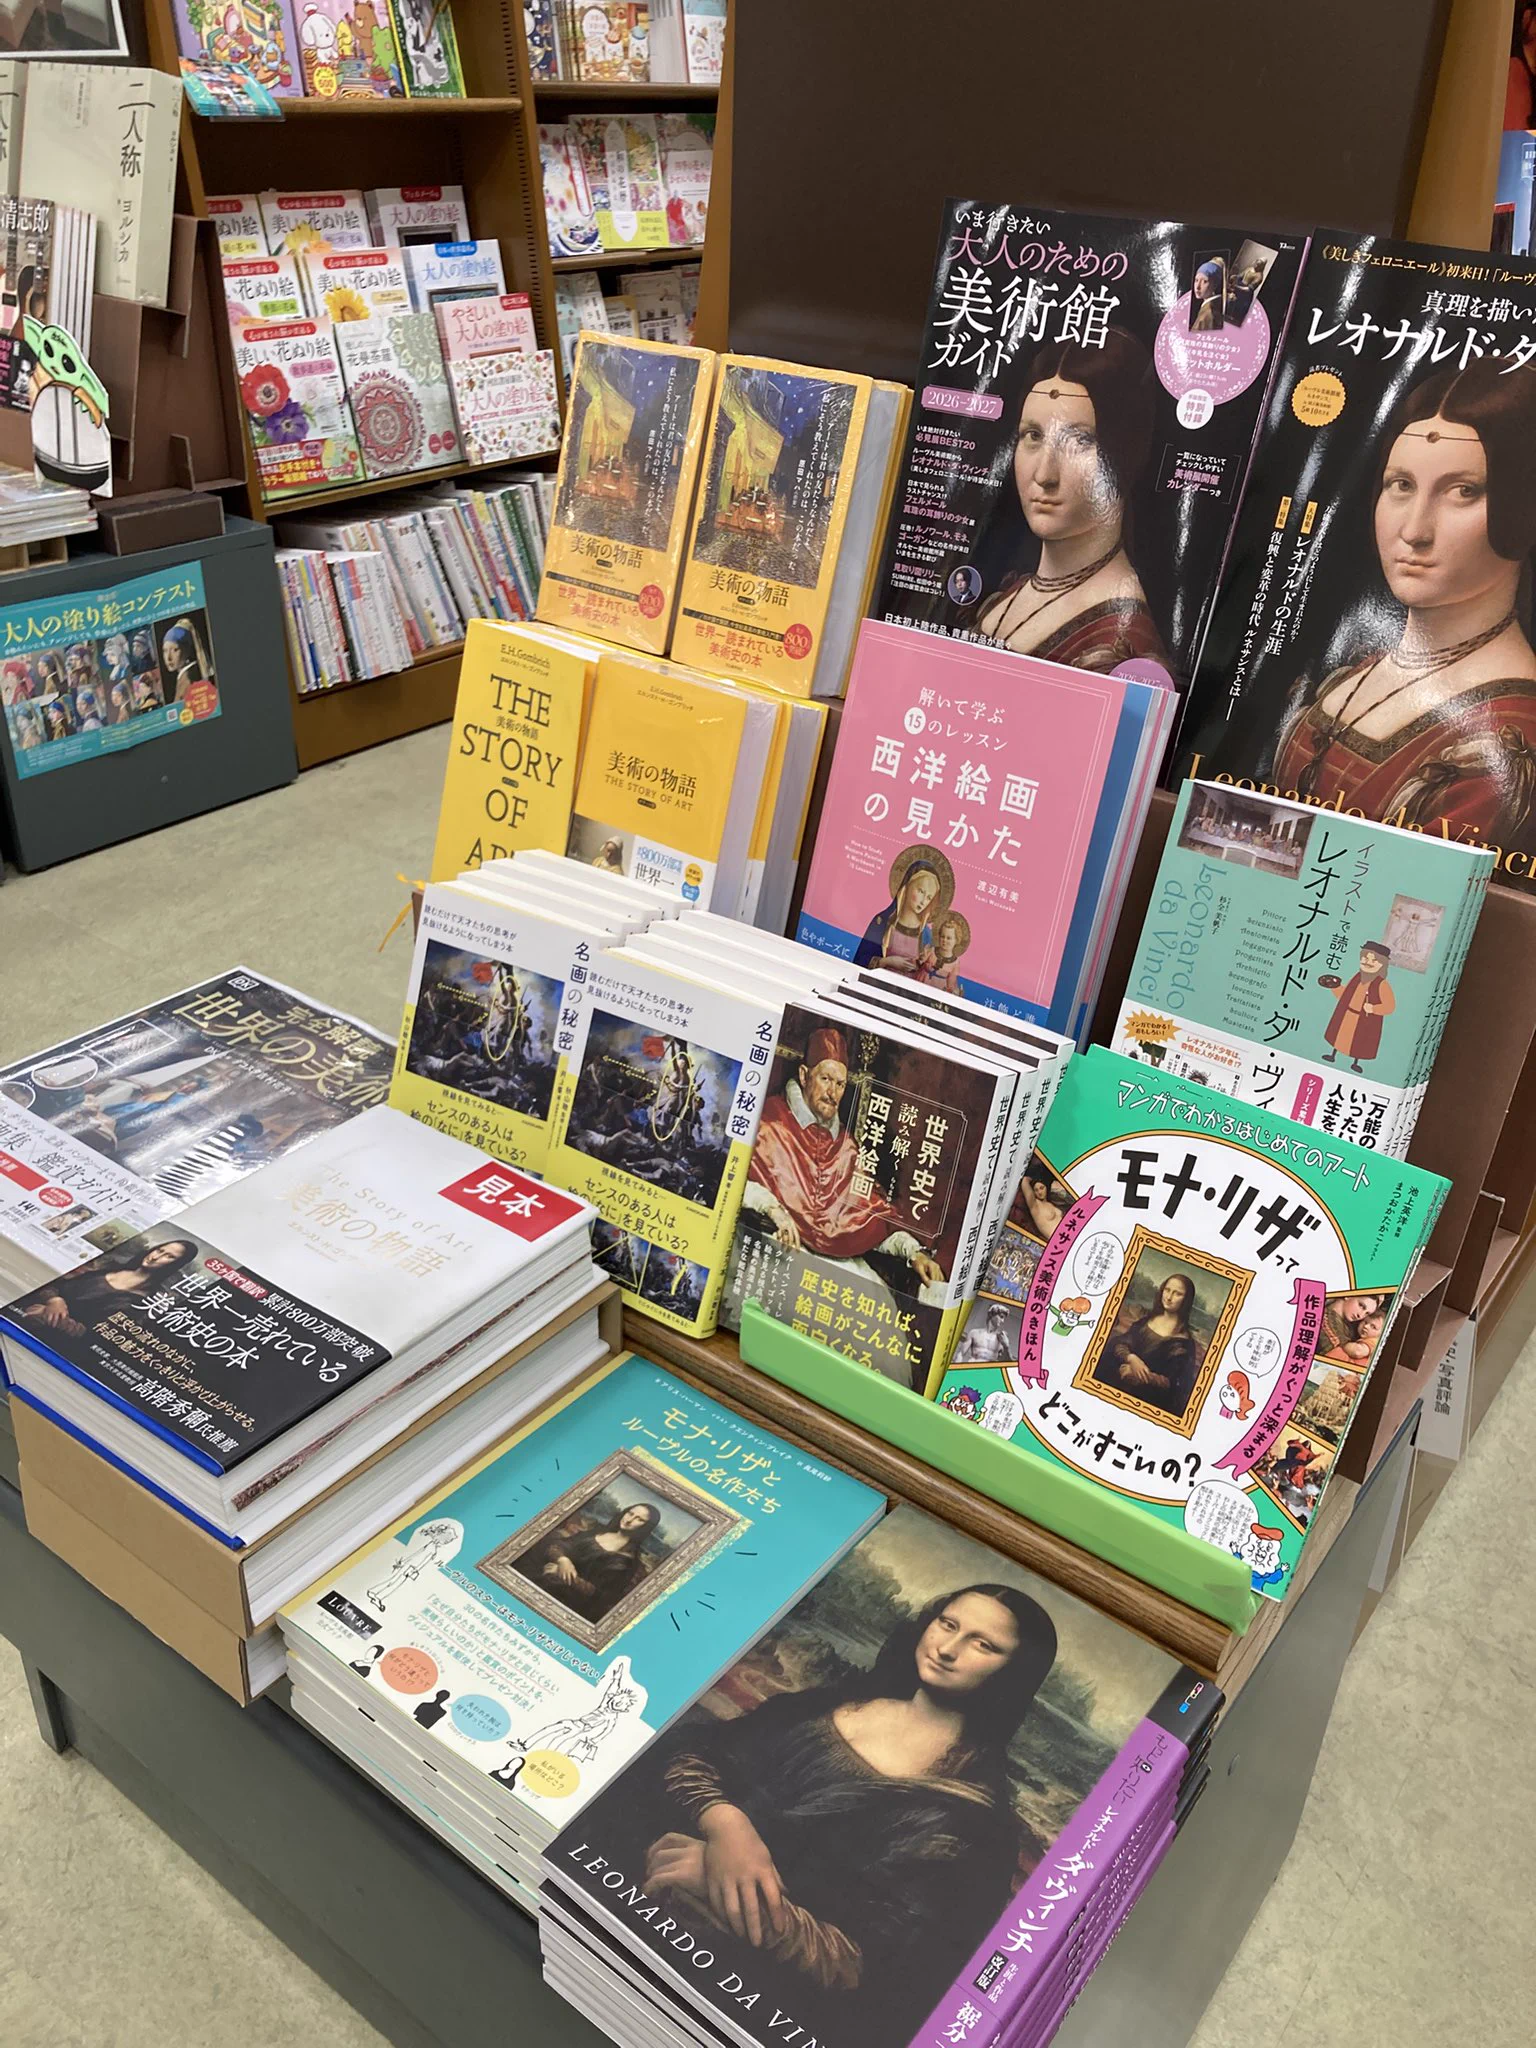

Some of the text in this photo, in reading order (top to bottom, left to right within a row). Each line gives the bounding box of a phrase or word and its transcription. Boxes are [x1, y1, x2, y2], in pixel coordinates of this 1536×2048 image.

[118, 83, 155, 178] 二人称
[0, 200, 49, 233] 清志郎
[118, 199, 135, 262] ヨルシカ
[272, 210, 360, 234] 美しい花ぬり絵
[390, 203, 460, 227] 大人の塗り絵
[953, 209, 1052, 234] いま行きたい
[422, 260, 497, 282] 大人の塗り絵
[950, 227, 1129, 281] 大人のための
[317, 267, 403, 294] 美しい花ぬり絵
[451, 306, 497, 325] やさしい
[456, 318, 529, 344] 大人の塗り絵
[932, 265, 1120, 349] 美術館
[1421, 290, 1536, 324] 真理を描い
[238, 337, 332, 369] 美しい花ぬり絵
[926, 335, 1019, 380] ガイド
[470, 385, 546, 412] 大人の塗り絵
[911, 455, 989, 476] レオナルド・ダ・ヴィンチ
[915, 433, 976, 450] 必見展BEST20
[1176, 460, 1224, 473] チェックしやすい
[1177, 451, 1227, 465] 一覧になっていて
[905, 494, 948, 509] フェルメール
[907, 479, 945, 492] 日本で見られる
[1174, 468, 1220, 486] 美術展開催
[571, 534, 644, 569] 美術の物語
[558, 585, 639, 617] 世界一読まれている
[709, 569, 790, 607] 美術の物語
[1248, 530, 1284, 627] 復興と変革の時代
[1265, 536, 1311, 656] レオナルドの生涯
[4, 580, 197, 647] 大人の塗り絵コンテスト
[571, 602, 620, 625] 美術史の本
[884, 612, 1013, 651] 日本初上陸作品、貴重作品が続々
[695, 622, 784, 658] 世界一読まれている
[709, 642, 763, 668] 美術史の本
[786, 633, 808, 648] 800
[490, 673, 552, 727] THE
[918, 687, 1006, 725] 解いて学ぶ
[496, 715, 539, 741] 美術の物語
[460, 723, 563, 788] STORY
[607, 750, 697, 799] 美術の物語
[869, 734, 1040, 821] 西洋絵画
[485, 788, 529, 829] OF
[605, 774, 694, 812] THE STORY OF ART
[864, 791, 1023, 868] の見かた
[424, 904, 518, 941] 読むだけで天才たちの思考が
[1325, 843, 1376, 972] イラストで読む
[422, 916, 514, 953] 見抜けるようになってしまう本
[1136, 880, 1188, 1002] da Vinci
[1166, 864, 1228, 1010] Leonardo
[558, 942, 590, 1051] 名画の秘密
[586, 986, 690, 1028] 見抜けるようになってしまう本
[589, 972, 694, 1016] 読むだけで天才たちの思考が
[276, 1006, 384, 1060] 完全解読
[1131, 1020, 1171, 1031] マンガでわかる!
[1186, 1035, 1242, 1061] レオナルド少年は、
[731, 1020, 773, 1137] 名画の秘密
[426, 1100, 514, 1142] センスのある人は
[1321, 1083, 1344, 1130] 人生を
[849, 1092, 893, 1201] 西洋絵画
[889, 1103, 920, 1171] 読み解く
[1115, 1078, 1371, 1192] マンガでわかるはじめてのアート
[909, 1114, 949, 1221] 世界史で
[354, 1187, 408, 1222] Story
[411, 1218, 441, 1233] of
[437, 1232, 475, 1253] Art
[463, 1174, 546, 1219] 見本
[585, 1177, 676, 1228] センスのある人は
[1115, 1148, 1322, 1274] モナ・リザって
[1376, 1182, 1402, 1242] まつおかたかこ
[1397, 1186, 1420, 1226] 池上英洋
[276, 1183, 451, 1279] 美術の物語
[732, 1235, 751, 1296] 新たな鑑賞体験
[1023, 1203, 1091, 1363] ルネサンス美術のきほん
[170, 1272, 348, 1384] 世界一売れている
[206, 1258, 376, 1363] 35ヶ国で翻訳 累計800万部突破
[799, 1268, 921, 1340] 歴史を知れば、
[106, 1311, 197, 1373] 歴史の流れのなかに、
[131, 1291, 260, 1370] 美術史の本
[794, 1294, 922, 1365] 絵画がこんなに
[92, 1322, 256, 1433] 作品の魅力をくっきりと浮かび上がらせる。
[661, 1381, 706, 1412] アリス・ハーマン
[1243, 1293, 1321, 1458] 作品理解がぐっと深まる
[131, 1378, 240, 1454] 高階秀爾氏推薦
[1036, 1391, 1201, 1488] どこがすごいの?
[621, 1415, 783, 1514] ルーヴルの名作たち
[663, 1407, 781, 1487] モナ・リザと
[729, 1424, 792, 1460] クエンティン・ブレイク
[328, 1597, 372, 1634] LOUVRE
[434, 1559, 606, 1684] ルーヴルのスターはモナ・リザだけじゃない!
[463, 1604, 542, 1666] 30の名作たちみずから、
[421, 1607, 543, 1703] 素晴らしいのか」と鑑賞のポイントを、
[427, 1593, 560, 1693] 「なぜ自分たちがモナ・リザと同じくらい
[1113, 1734, 1170, 1805] もっと知りたい
[1000, 1804, 1119, 1955] レオナルド・ダ・ヴィンチ
[568, 1843, 715, 1968] LEONARDO
[716, 1972, 762, 2011] DA
[975, 1953, 1006, 1991] 改訂版
[987, 1962, 1019, 2005] 生涯と作品
